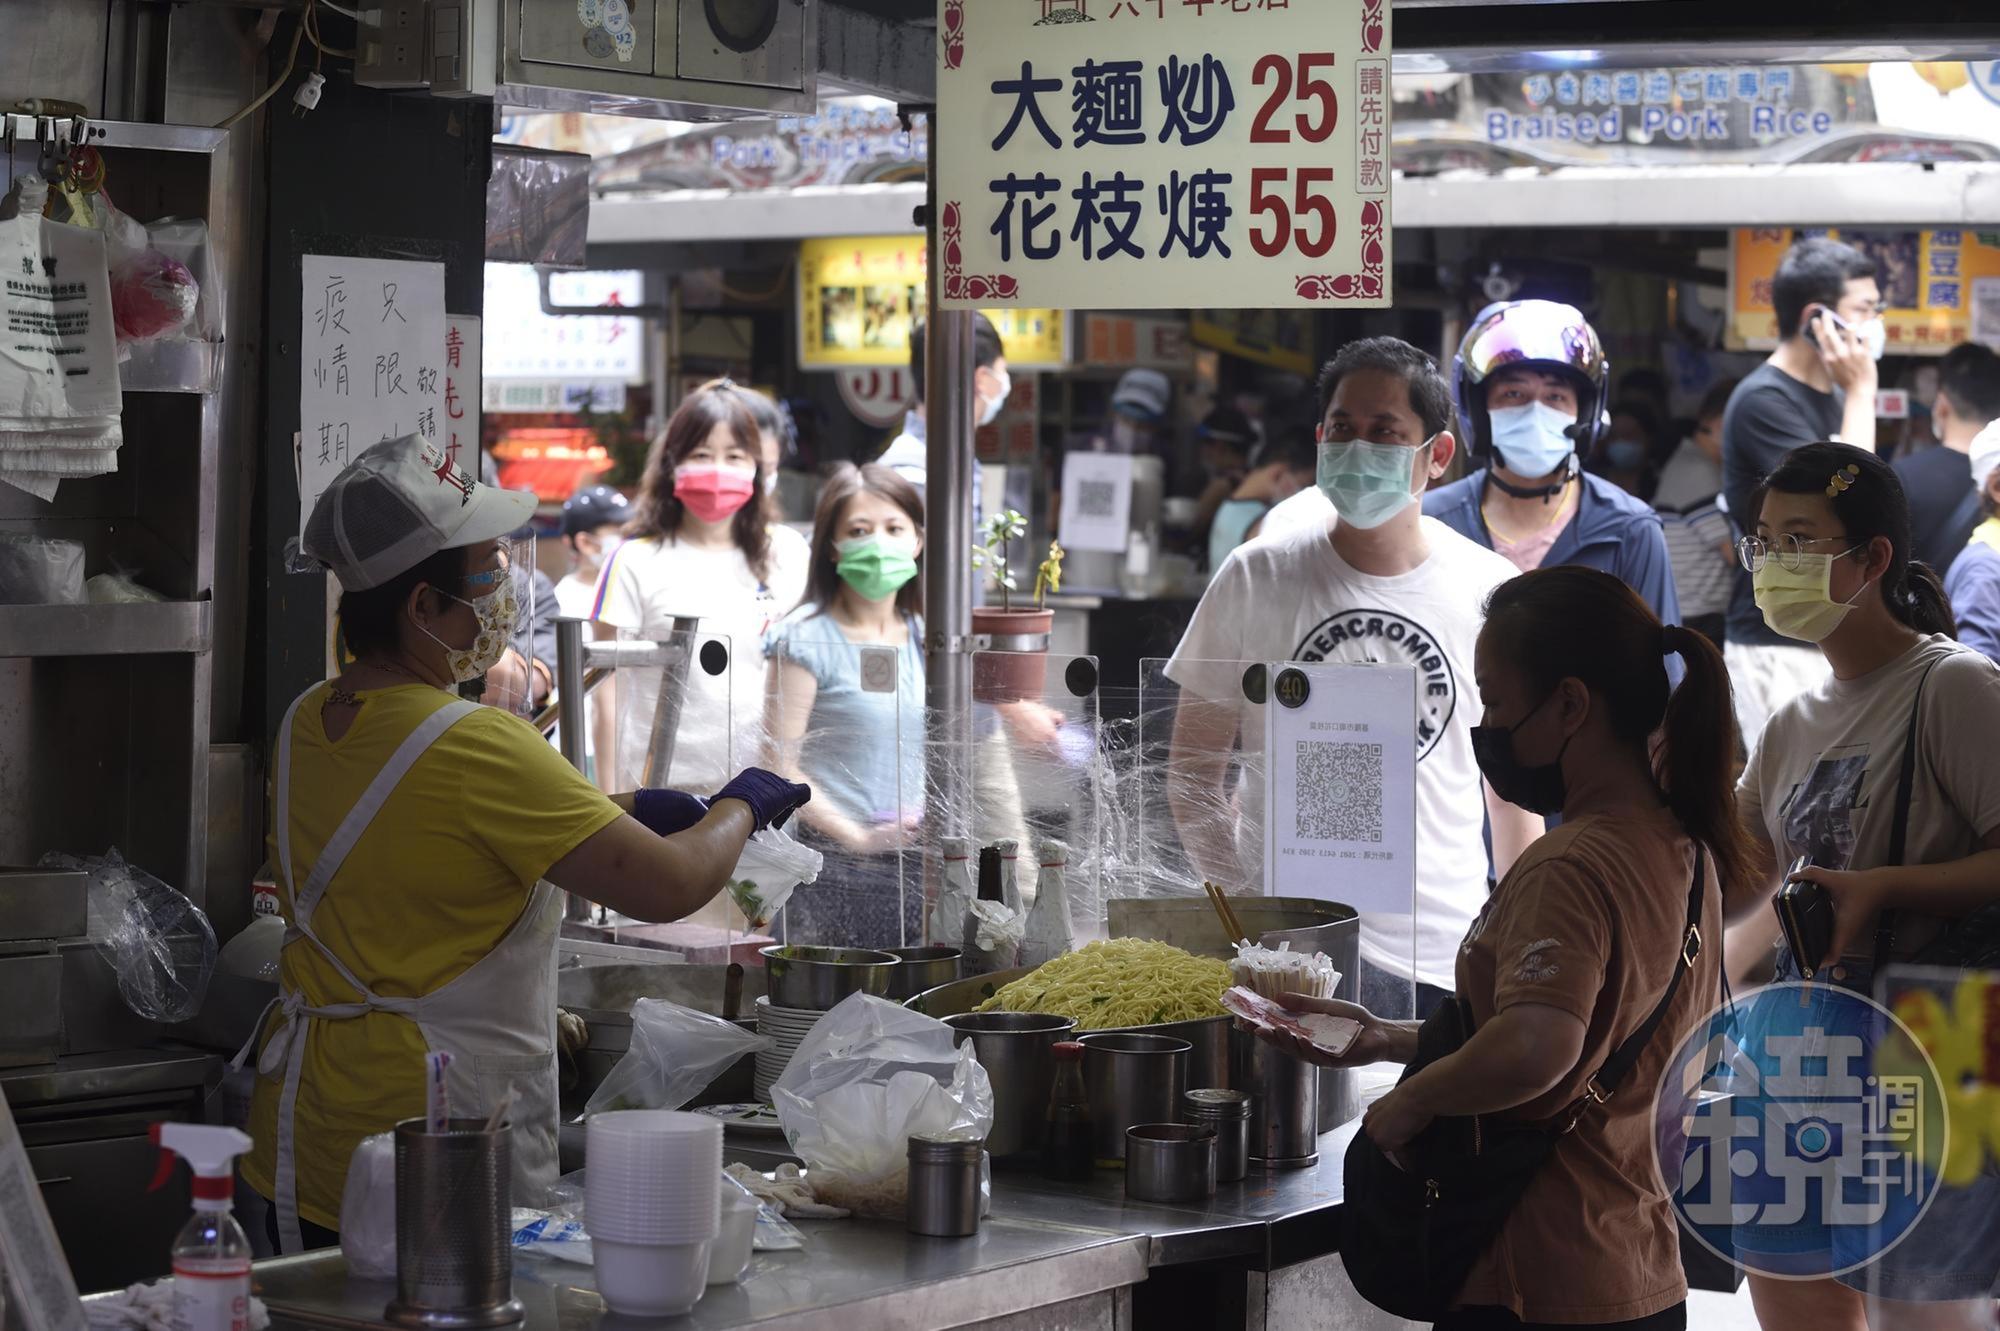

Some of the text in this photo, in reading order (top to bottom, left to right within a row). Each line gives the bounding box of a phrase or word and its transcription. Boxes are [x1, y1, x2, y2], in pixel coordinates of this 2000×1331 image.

[991, 53, 1338, 151] 大麵炒 25
[1360, 67, 1383, 186] 請先付款
[1486, 105, 1831, 141] Braised Pork Rice
[1249, 167, 1337, 257] 55
[314, 275, 351, 504] 疫情期
[1280, 676, 1300, 699] 40
